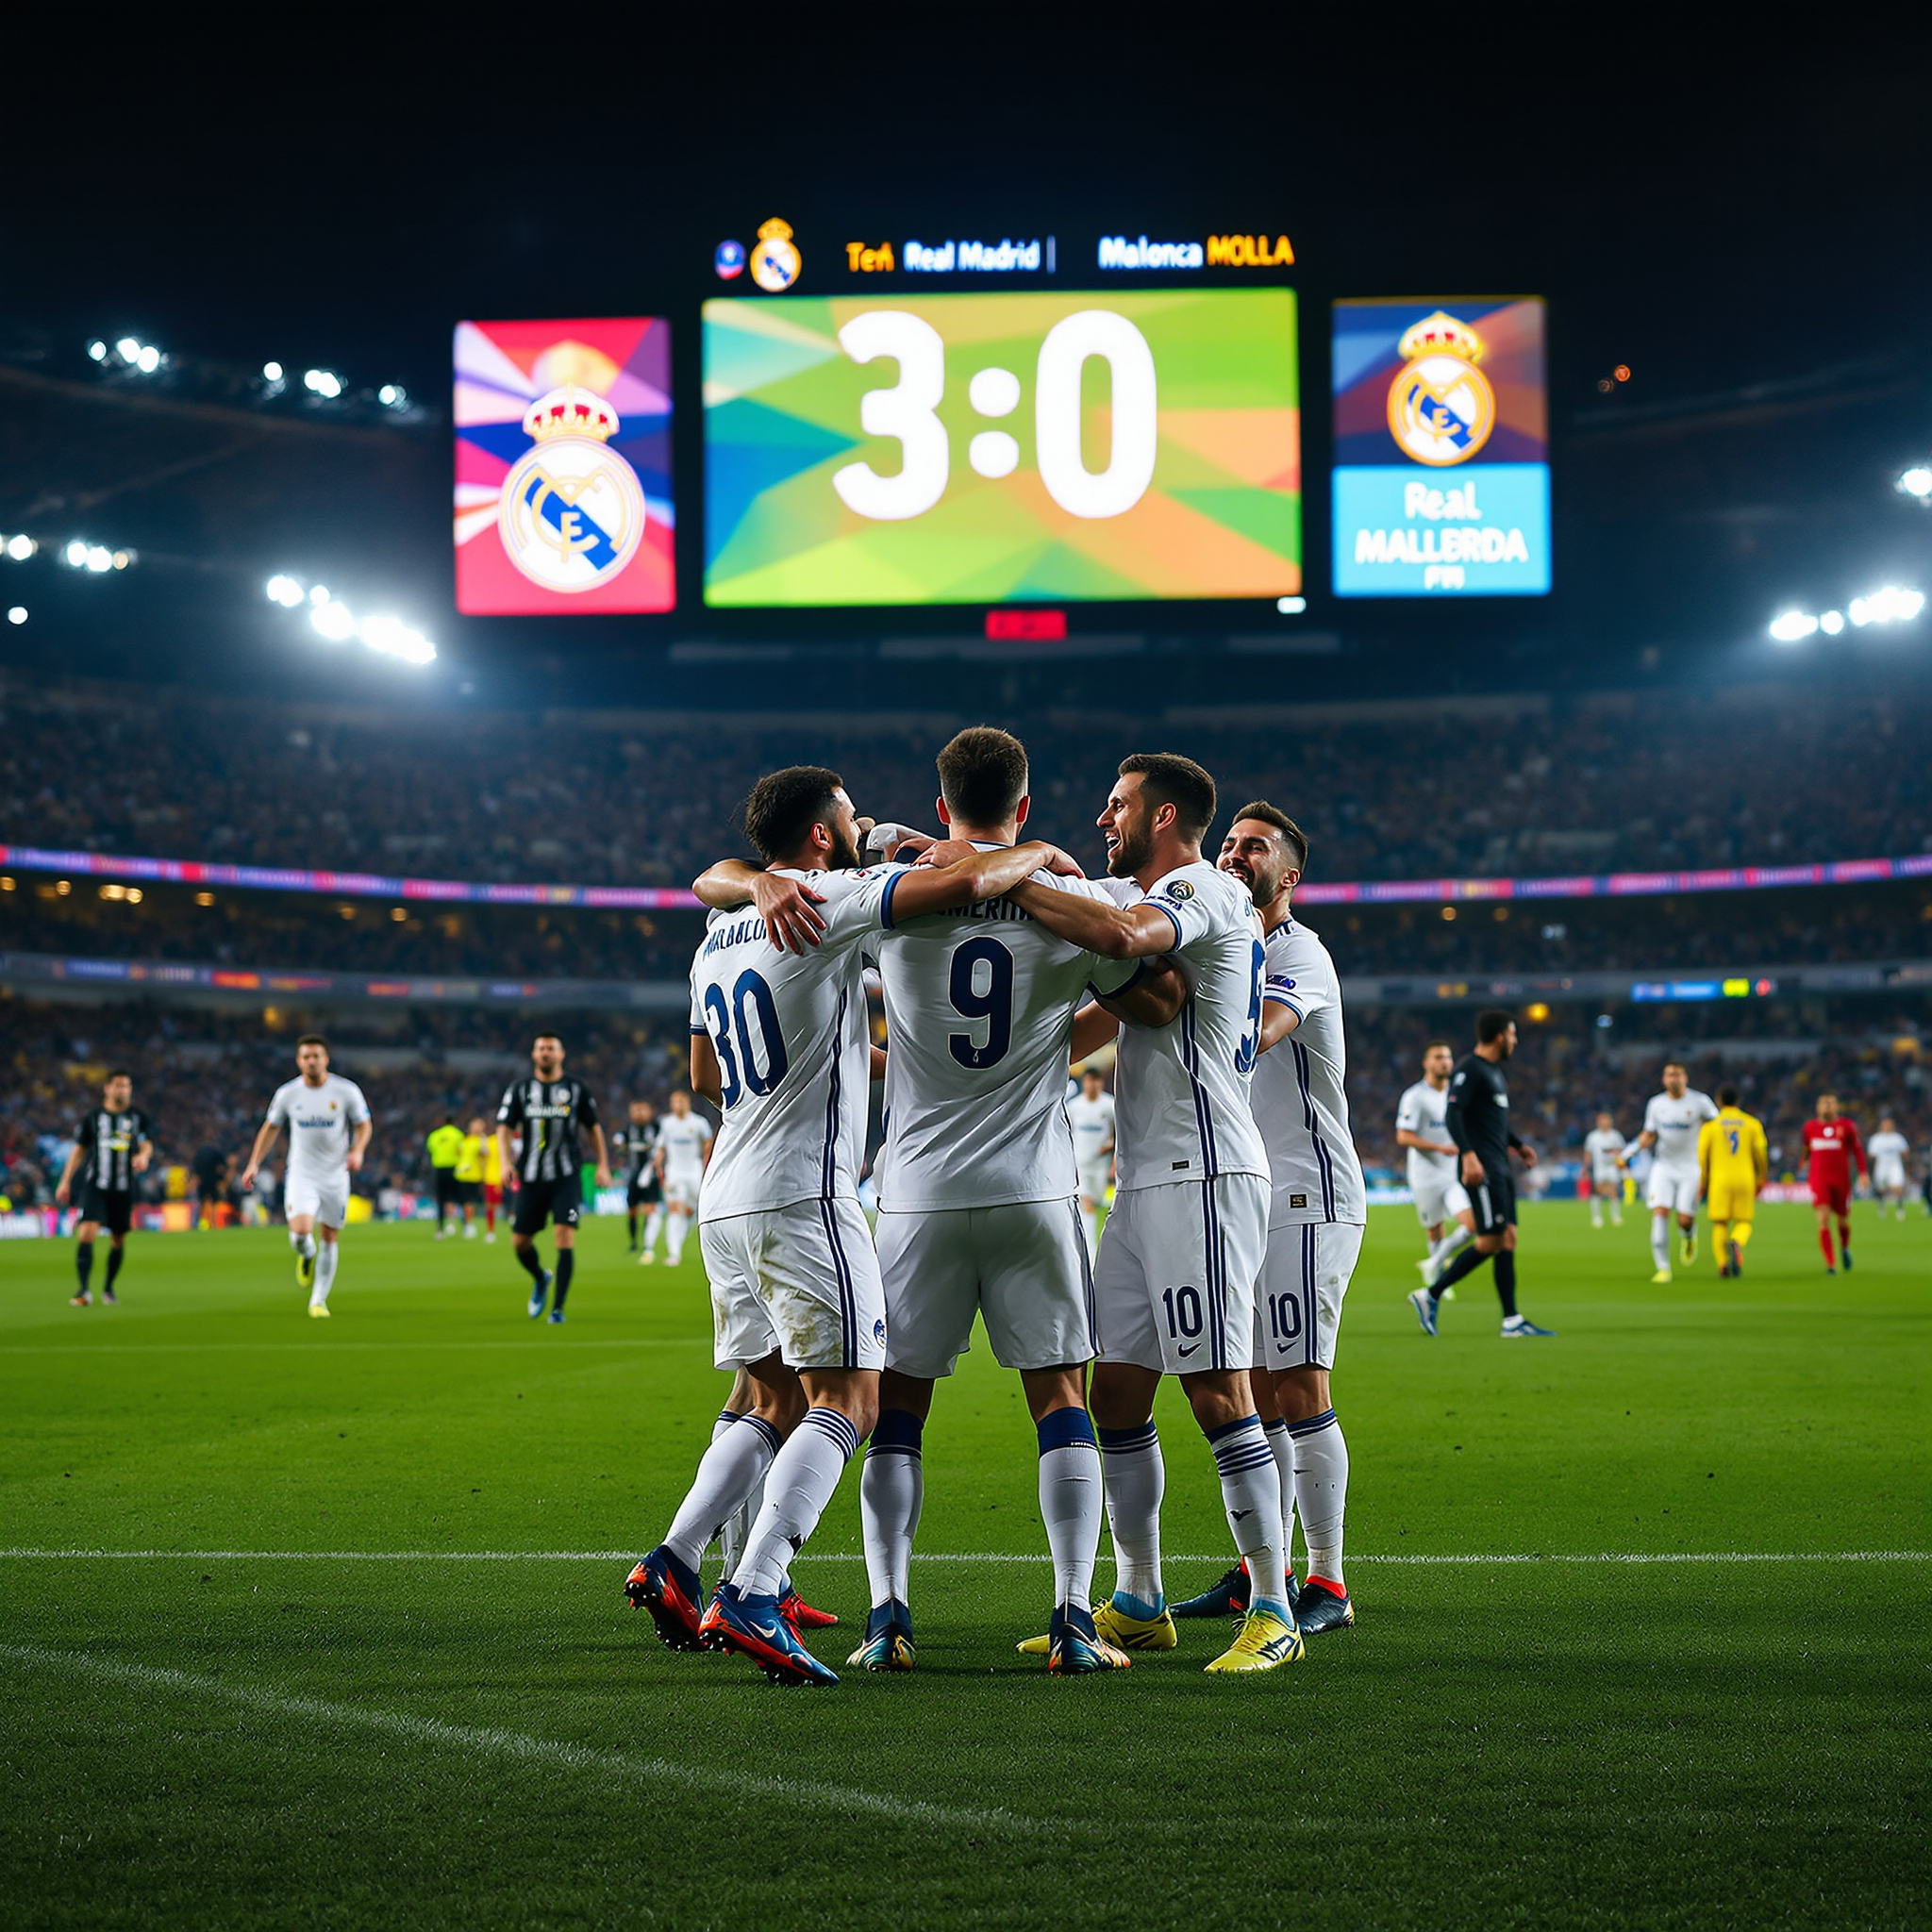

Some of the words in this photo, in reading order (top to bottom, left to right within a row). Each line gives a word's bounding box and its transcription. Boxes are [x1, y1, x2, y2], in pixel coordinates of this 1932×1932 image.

[903, 239, 955, 272] Real
[958, 238, 1041, 272] Madrid
[1207, 235, 1295, 267] MOLLA
[832, 309, 1157, 520] 3:0
[1405, 481, 1482, 521] Real
[949, 937, 1013, 1069] 9
[705, 968, 789, 1110] 30
[1162, 1286, 1203, 1339] 10
[1269, 1292, 1303, 1339] 10
